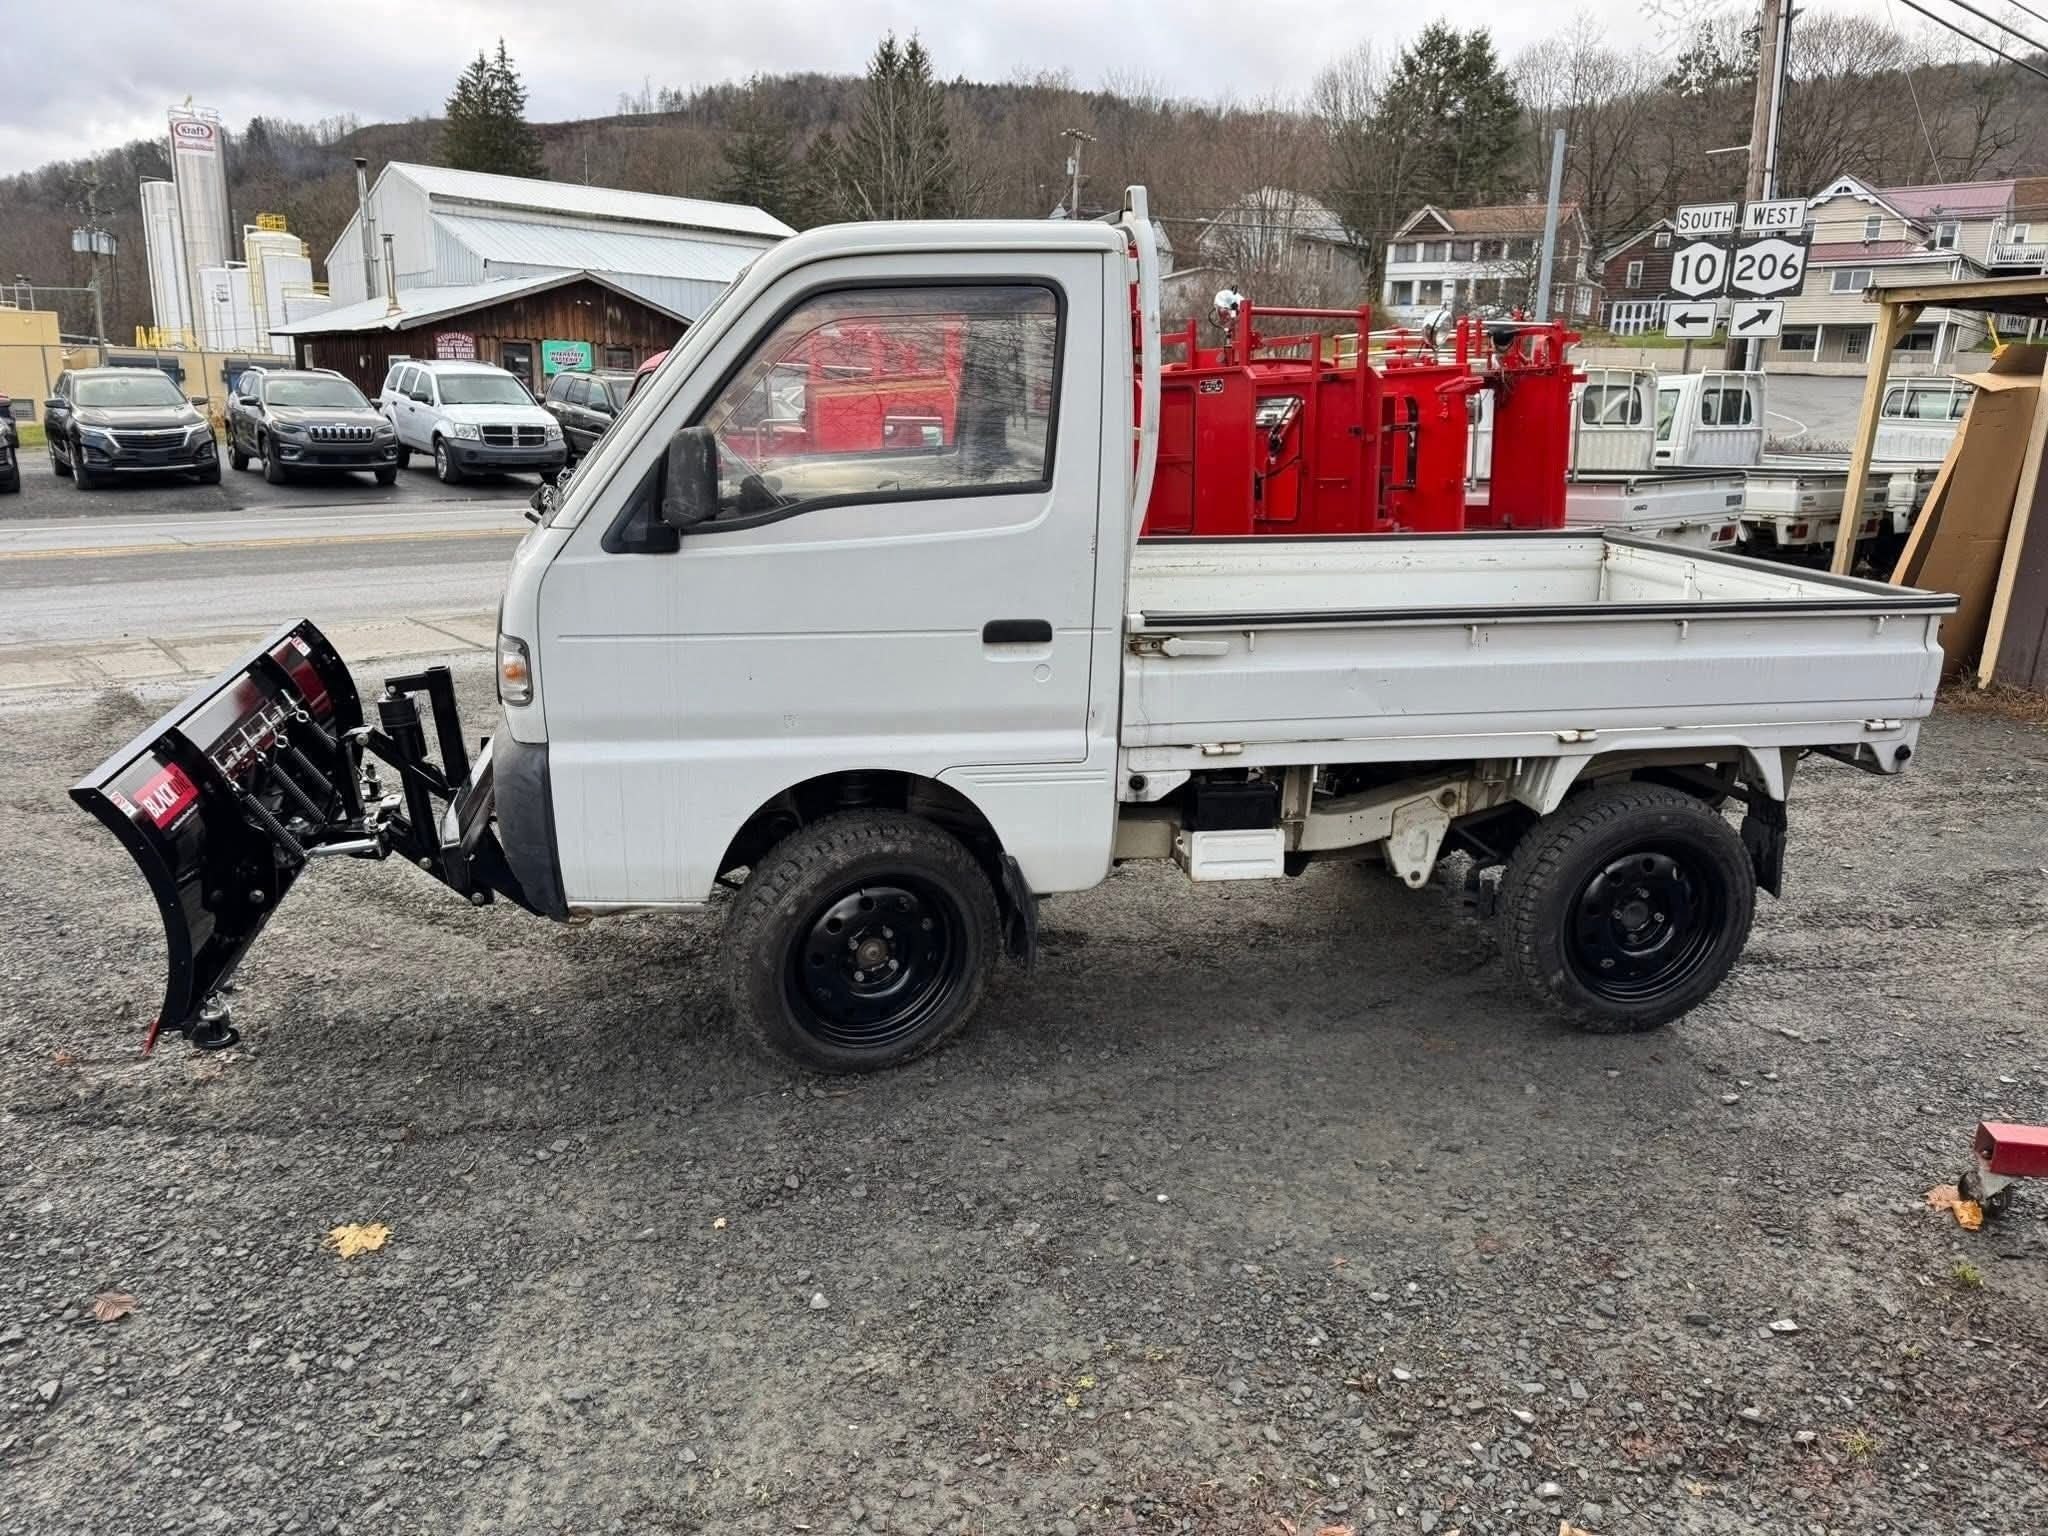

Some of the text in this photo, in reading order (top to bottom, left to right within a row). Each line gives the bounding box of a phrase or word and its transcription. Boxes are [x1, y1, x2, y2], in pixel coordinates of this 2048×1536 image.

[181, 126, 204, 136] Kraft
[1679, 211, 1733, 230] SOUTH
[1753, 206, 1798, 225] WEST
[1680, 253, 1717, 285] 10
[1735, 253, 1799, 281] 206
